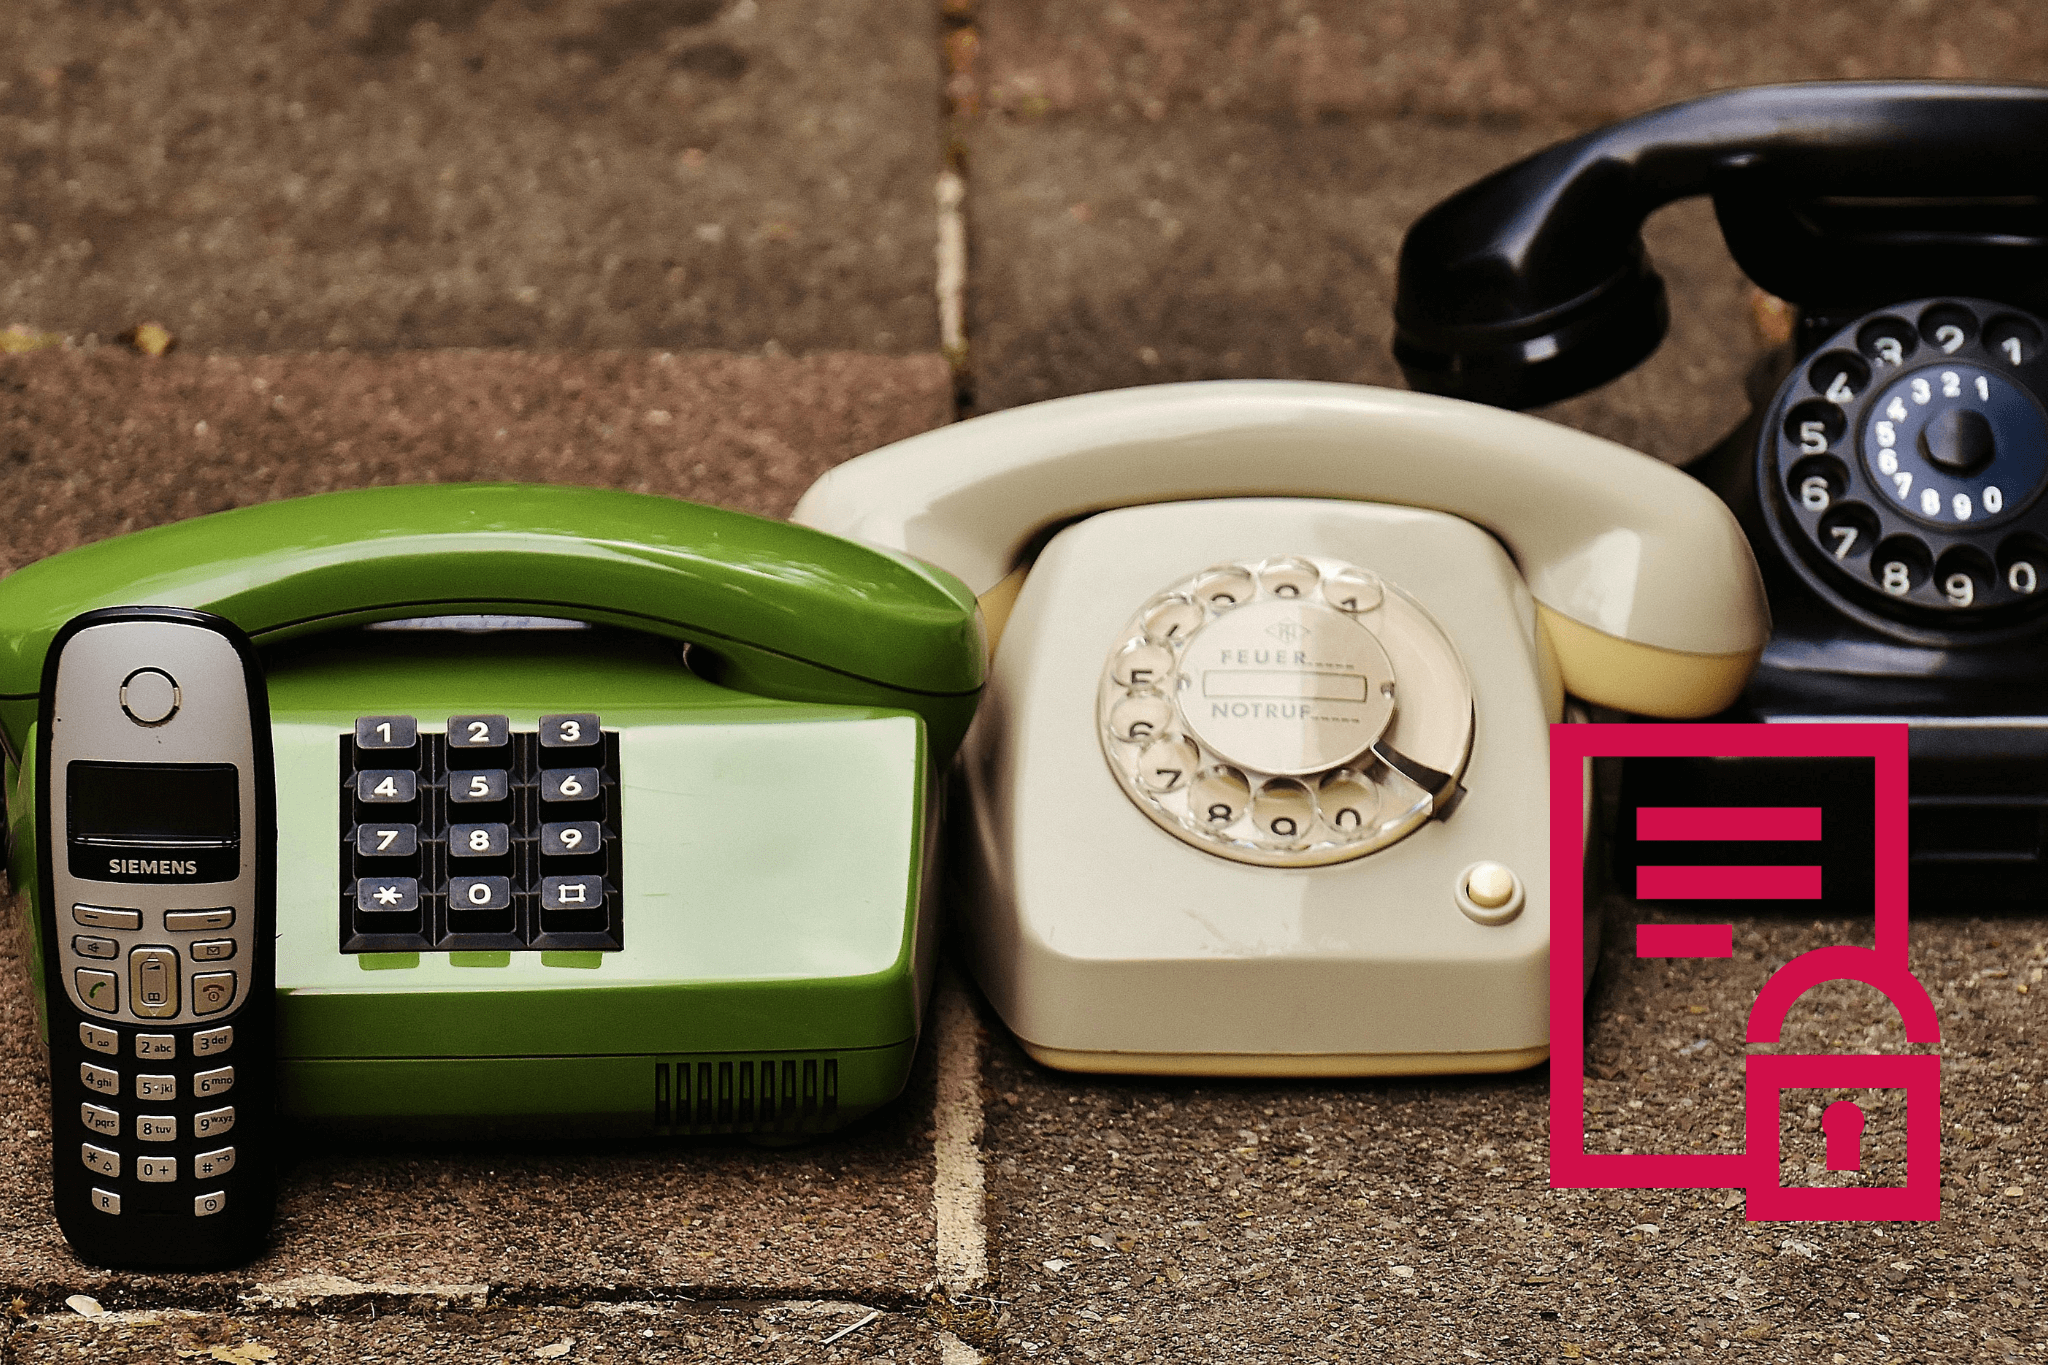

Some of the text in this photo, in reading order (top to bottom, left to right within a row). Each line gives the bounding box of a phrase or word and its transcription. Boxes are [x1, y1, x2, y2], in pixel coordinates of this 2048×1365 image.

[2002, 338, 2021, 365] 1
[1911, 378, 1931, 405] 3
[1941, 371, 1961, 397] 2
[1975, 376, 1988, 401] 1
[1886, 397, 1907, 423] 4
[1801, 422, 1827, 454] 5
[1875, 421, 1896, 448] 5
[1878, 448, 1898, 475] 6
[1802, 477, 1829, 511] 6
[1893, 472, 1913, 500] 7
[1953, 493, 1972, 520] 9
[1983, 486, 2002, 514] 0
[1831, 527, 1857, 560] 7
[1884, 562, 1910, 596] 8
[2009, 562, 2036, 593] 0
[1946, 573, 1973, 607] 9
[1212, 703, 1311, 719] NOTRUF
[377, 723, 391, 742] 1
[467, 722, 489, 742] 2
[560, 721, 580, 741] 3
[374, 777, 398, 796] 4
[469, 776, 489, 796] 5
[560, 776, 582, 795] 6
[377, 831, 398, 850] 7
[469, 830, 489, 851] 8
[560, 829, 582, 848] 9
[109, 859, 197, 875] SIEMENS
[469, 884, 491, 904] 0
[87, 1032, 93, 1043] 1
[141, 1042, 172, 1053] 2 abc
[201, 1035, 227, 1050] 3 def
[86, 1072, 112, 1088] 4 ghi
[143, 1083, 173, 1094] 5 jkl
[201, 1077, 233, 1091] 6 mno
[87, 1111, 115, 1128] 7 pqrs
[143, 1123, 172, 1135] 8 tuv
[201, 1115, 233, 1130] 9 wxyz
[144, 1164, 152, 1176] 0
[102, 1197, 109, 1207] R
